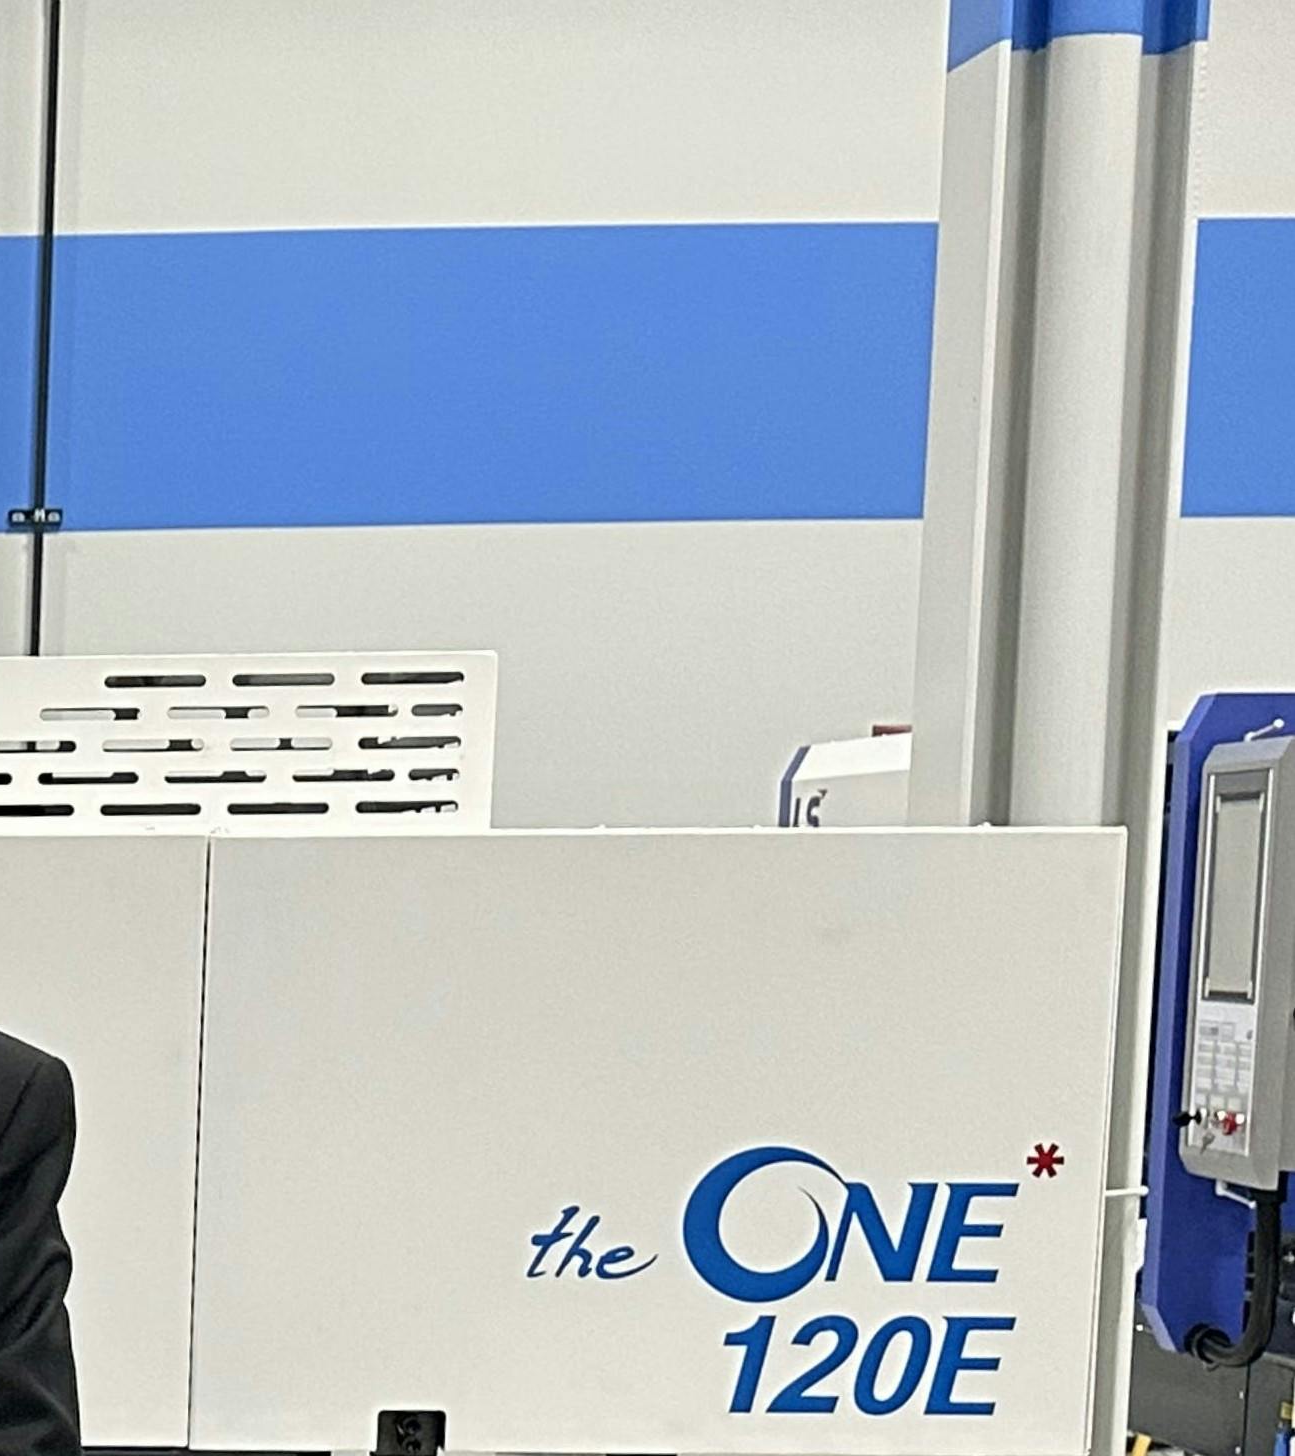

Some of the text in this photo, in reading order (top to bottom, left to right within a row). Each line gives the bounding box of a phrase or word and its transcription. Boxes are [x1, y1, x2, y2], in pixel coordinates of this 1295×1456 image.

[525, 1146, 1019, 1303] the ONE
[720, 1315, 1017, 1416] 120E
